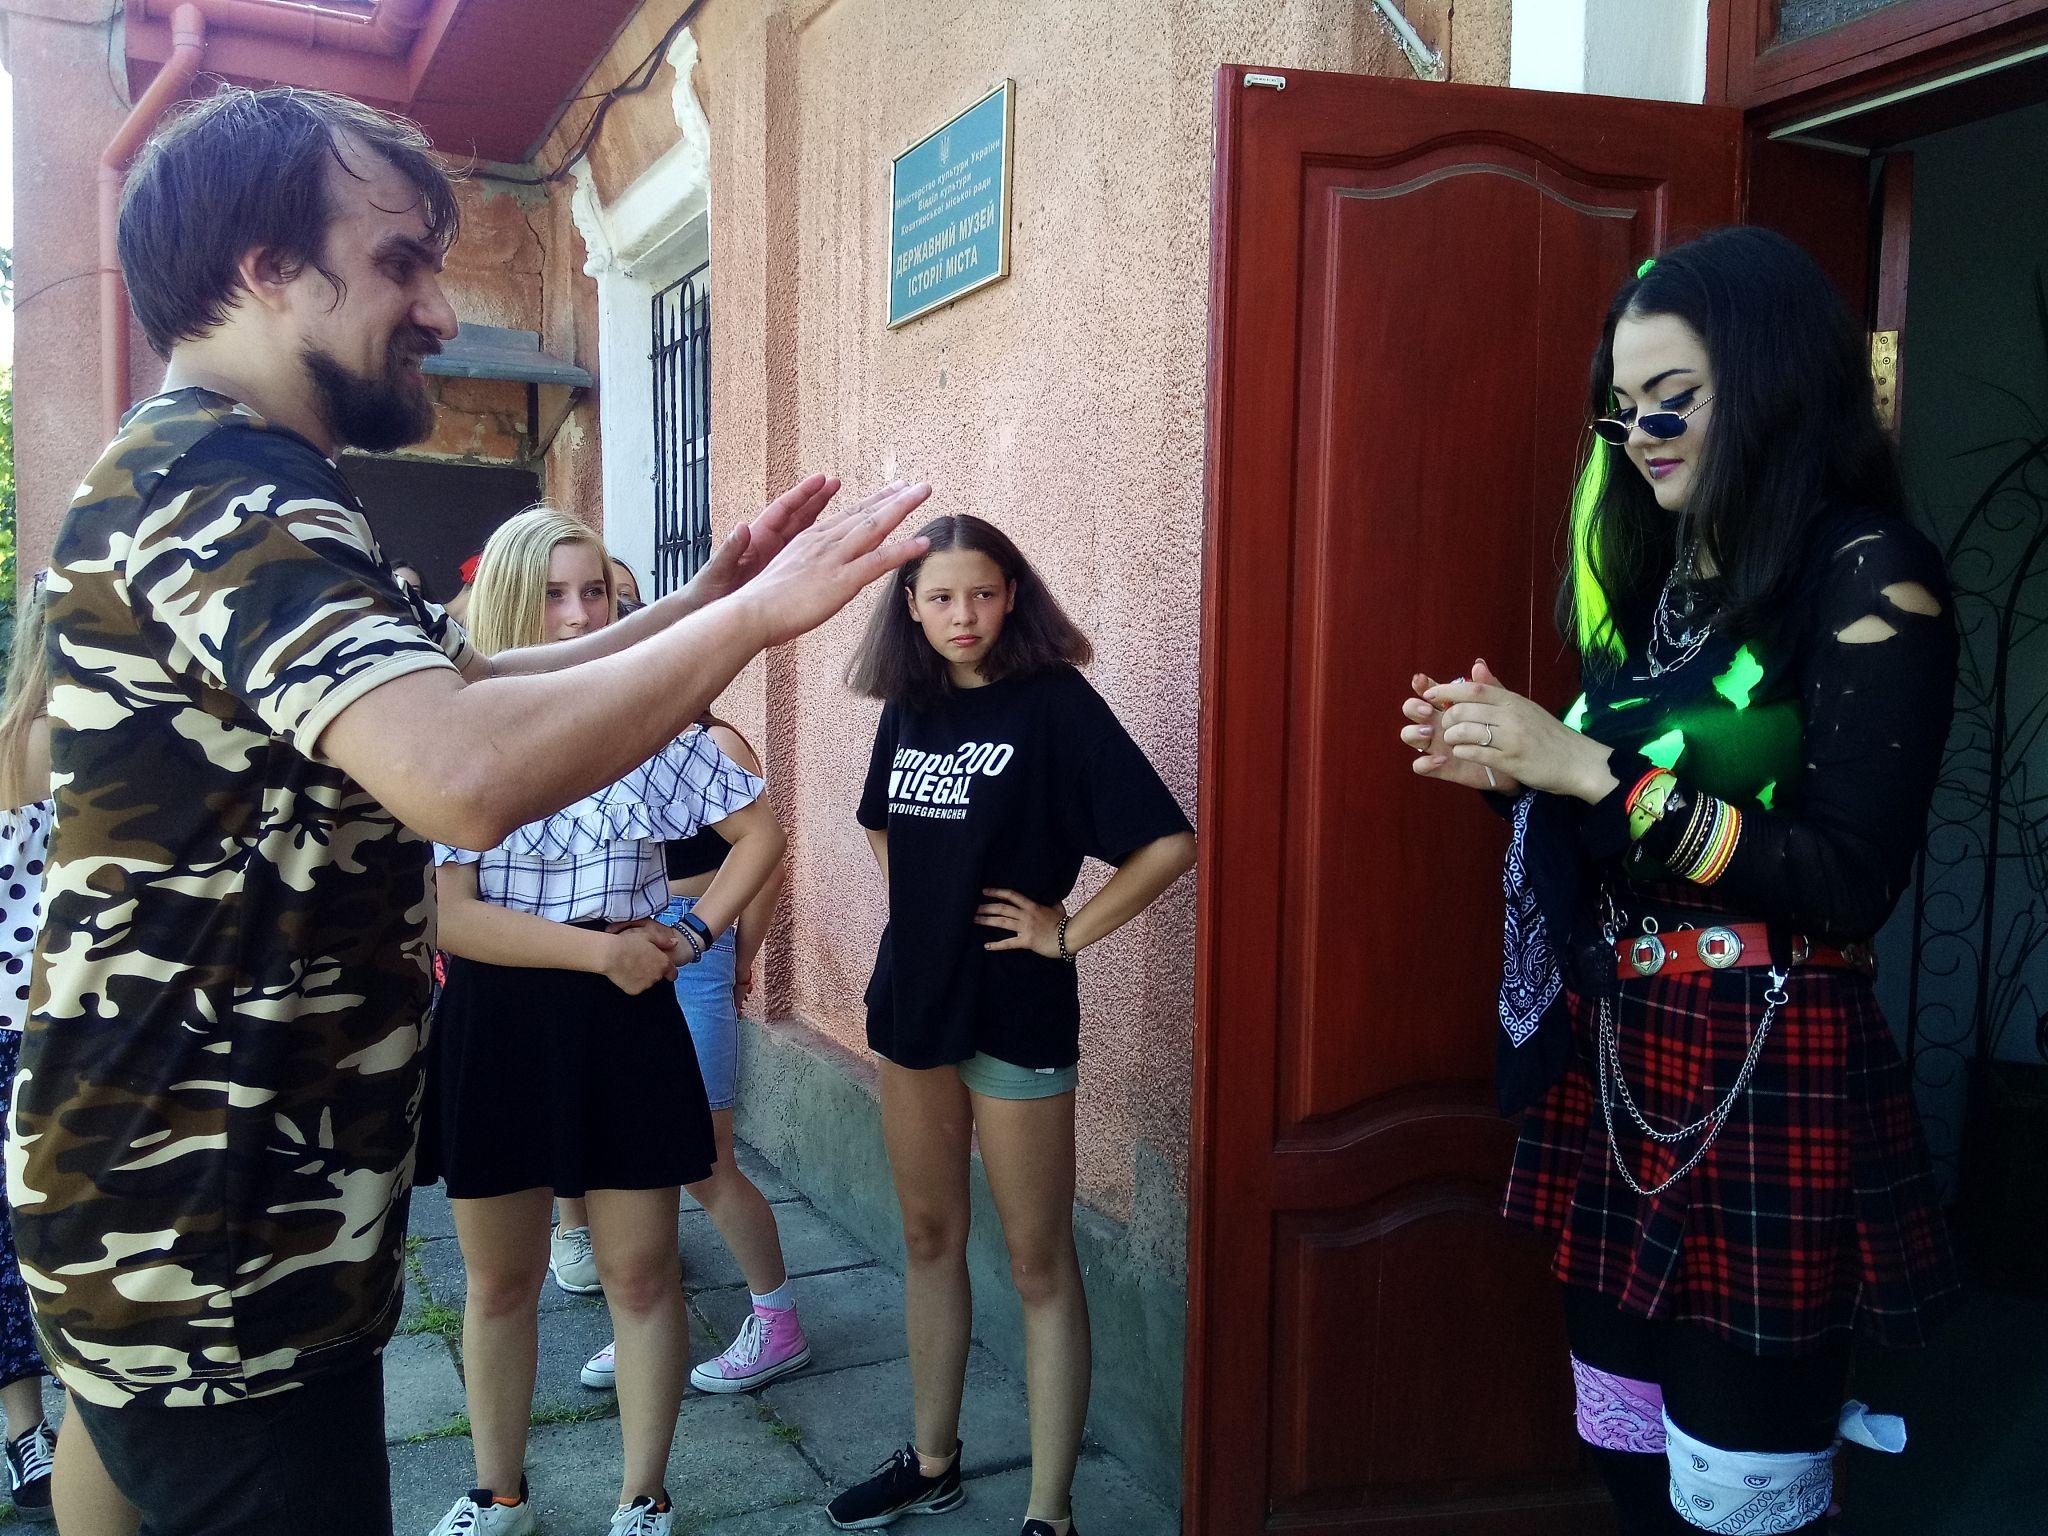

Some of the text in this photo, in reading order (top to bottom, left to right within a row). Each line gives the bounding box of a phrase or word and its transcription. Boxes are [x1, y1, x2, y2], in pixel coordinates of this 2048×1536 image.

[938, 159, 969, 185] культури
[971, 139, 1000, 164] України
[940, 173, 972, 198] культури
[946, 188, 972, 210] міської
[973, 177, 992, 197] ради
[896, 200, 995, 279] ДЕРЖАВНИЙ МУЗЕЙ
[908, 244, 978, 298] ІСТОРІЇ МІСТА
[892, 742, 1015, 791] empo200
